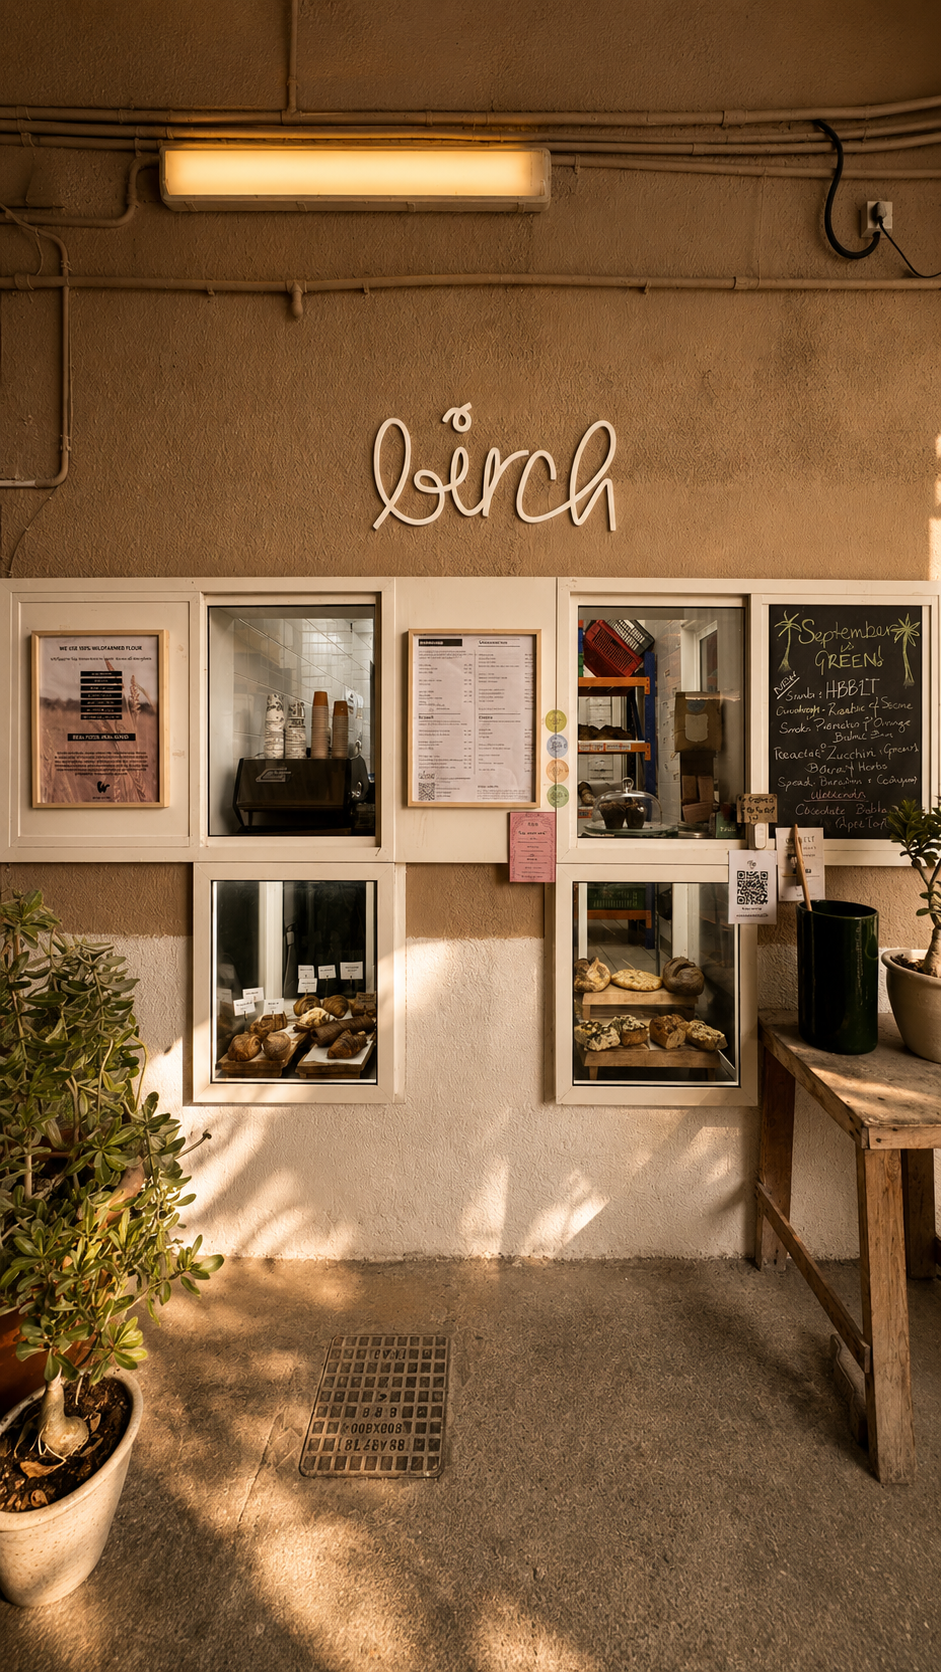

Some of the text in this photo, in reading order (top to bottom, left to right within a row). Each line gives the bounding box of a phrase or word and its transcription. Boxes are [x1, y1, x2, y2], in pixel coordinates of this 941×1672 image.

[373, 402, 616, 531] birch
[798, 619, 891, 648] September
[815, 646, 884, 675] GREEN!
